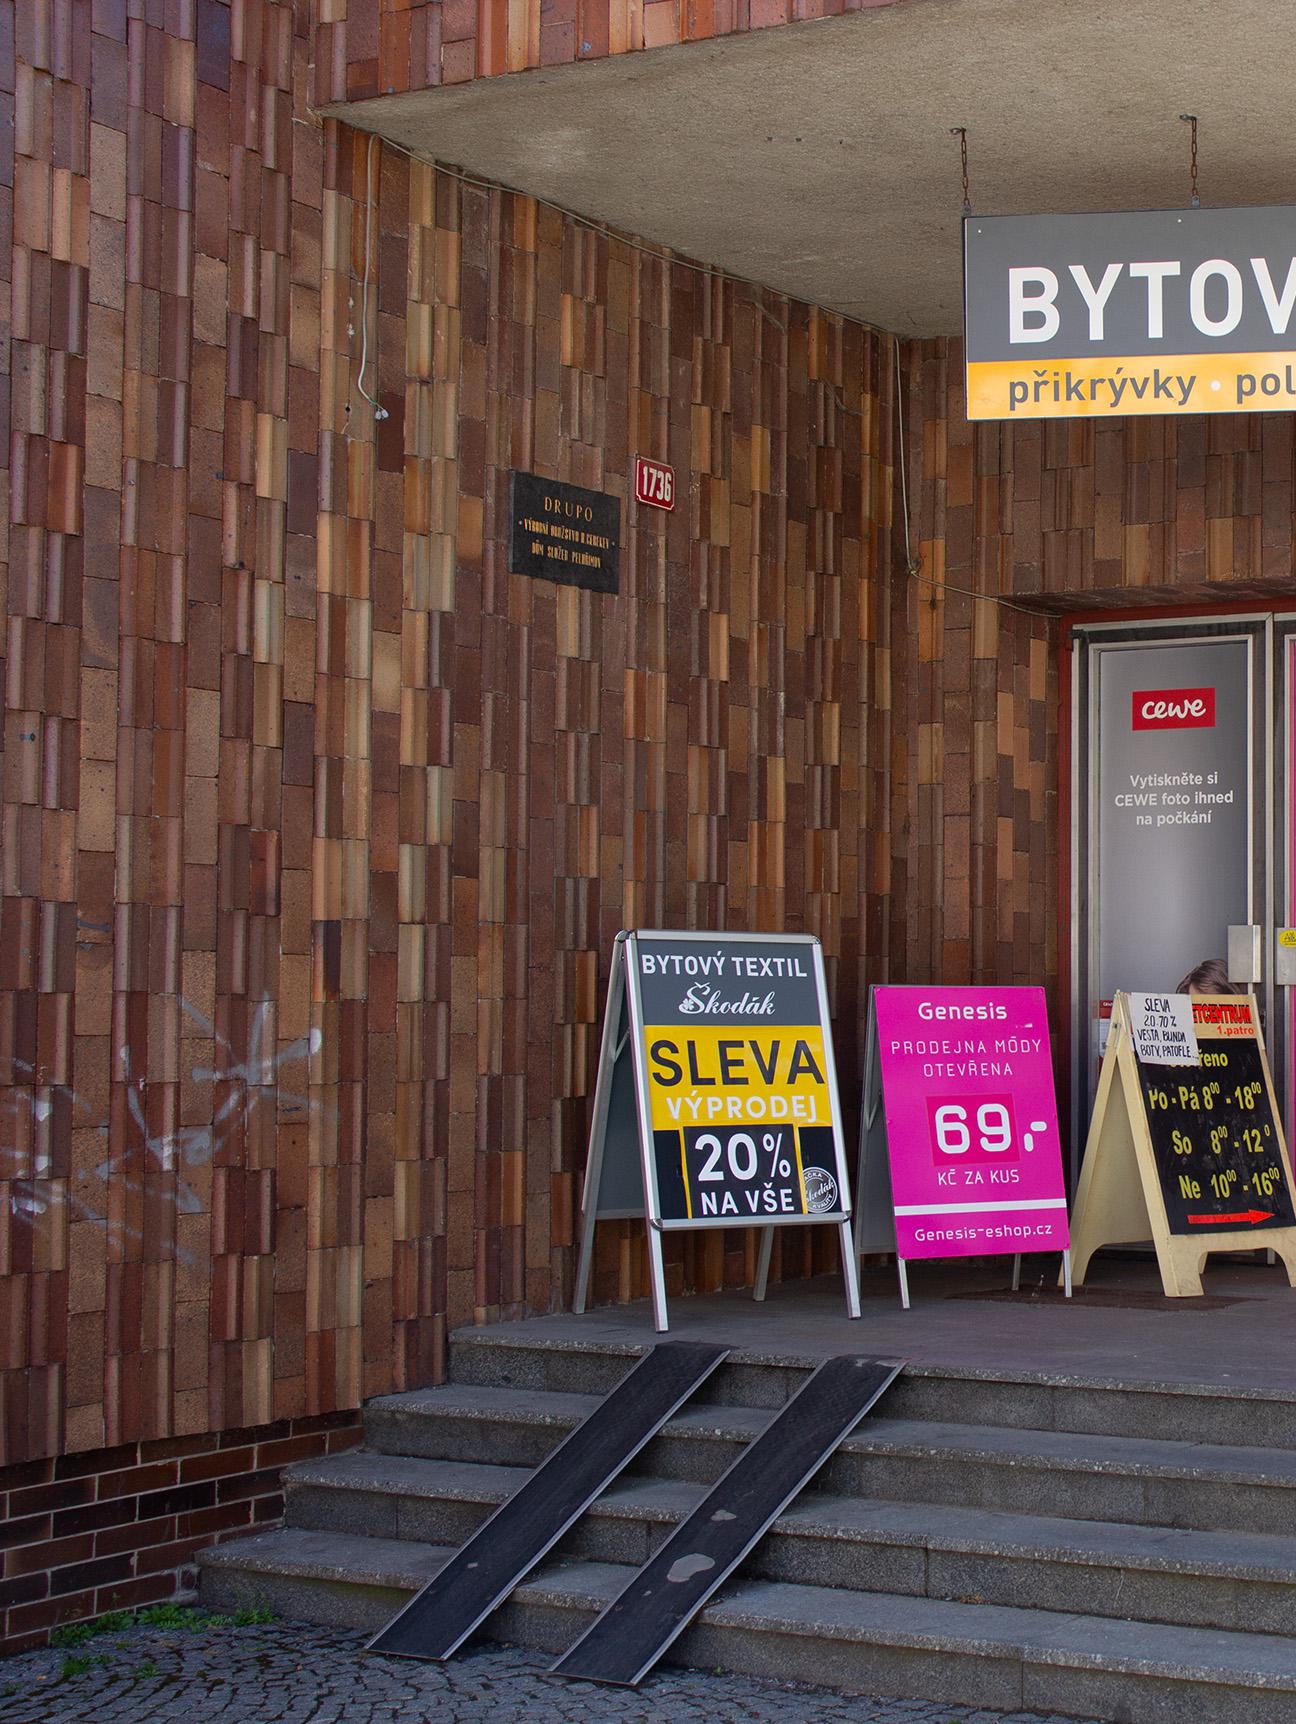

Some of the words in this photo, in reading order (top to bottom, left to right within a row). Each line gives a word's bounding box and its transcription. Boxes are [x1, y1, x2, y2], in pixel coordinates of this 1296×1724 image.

[1009, 368, 1196, 411] přikrývky
[643, 466, 672, 502] 1736
[544, 497, 593, 522] DRUPO
[1141, 699, 1207, 720] cewe
[1130, 772, 1203, 789] Vytiskněte
[1207, 771, 1218, 785] si
[1115, 793, 1158, 807] CEWE
[1162, 792, 1190, 806] foto
[1194, 790, 1234, 804] ihned
[1136, 814, 1152, 825] na
[1157, 810, 1212, 827] počkání
[642, 951, 726, 976] BYTOVÝ
[732, 957, 807, 977] TEXTIL
[679, 981, 776, 1015] Škodák
[1144, 998, 1171, 1013] SLEVA
[918, 1002, 1008, 1020] Genesis
[891, 1040, 987, 1055] PRODEJNA
[1162, 1030, 1186, 1043] BUNDA
[650, 1039, 825, 1087] SLEVA
[923, 1060, 1013, 1077] OTEVŘENA
[666, 1090, 816, 1123] VÝPRODEJ
[1178, 1086, 1200, 1110] Pá
[1172, 1129, 1192, 1155] So
[695, 1133, 791, 1182] 20%
[965, 1170, 984, 1184] ZA
[990, 1169, 1020, 1184] KUS
[1178, 1175, 1201, 1199] Ne
[701, 1191, 739, 1216] NA
[744, 1182, 795, 1212] VŠE
[914, 1224, 1053, 1242] Genesis-eshop.cz
